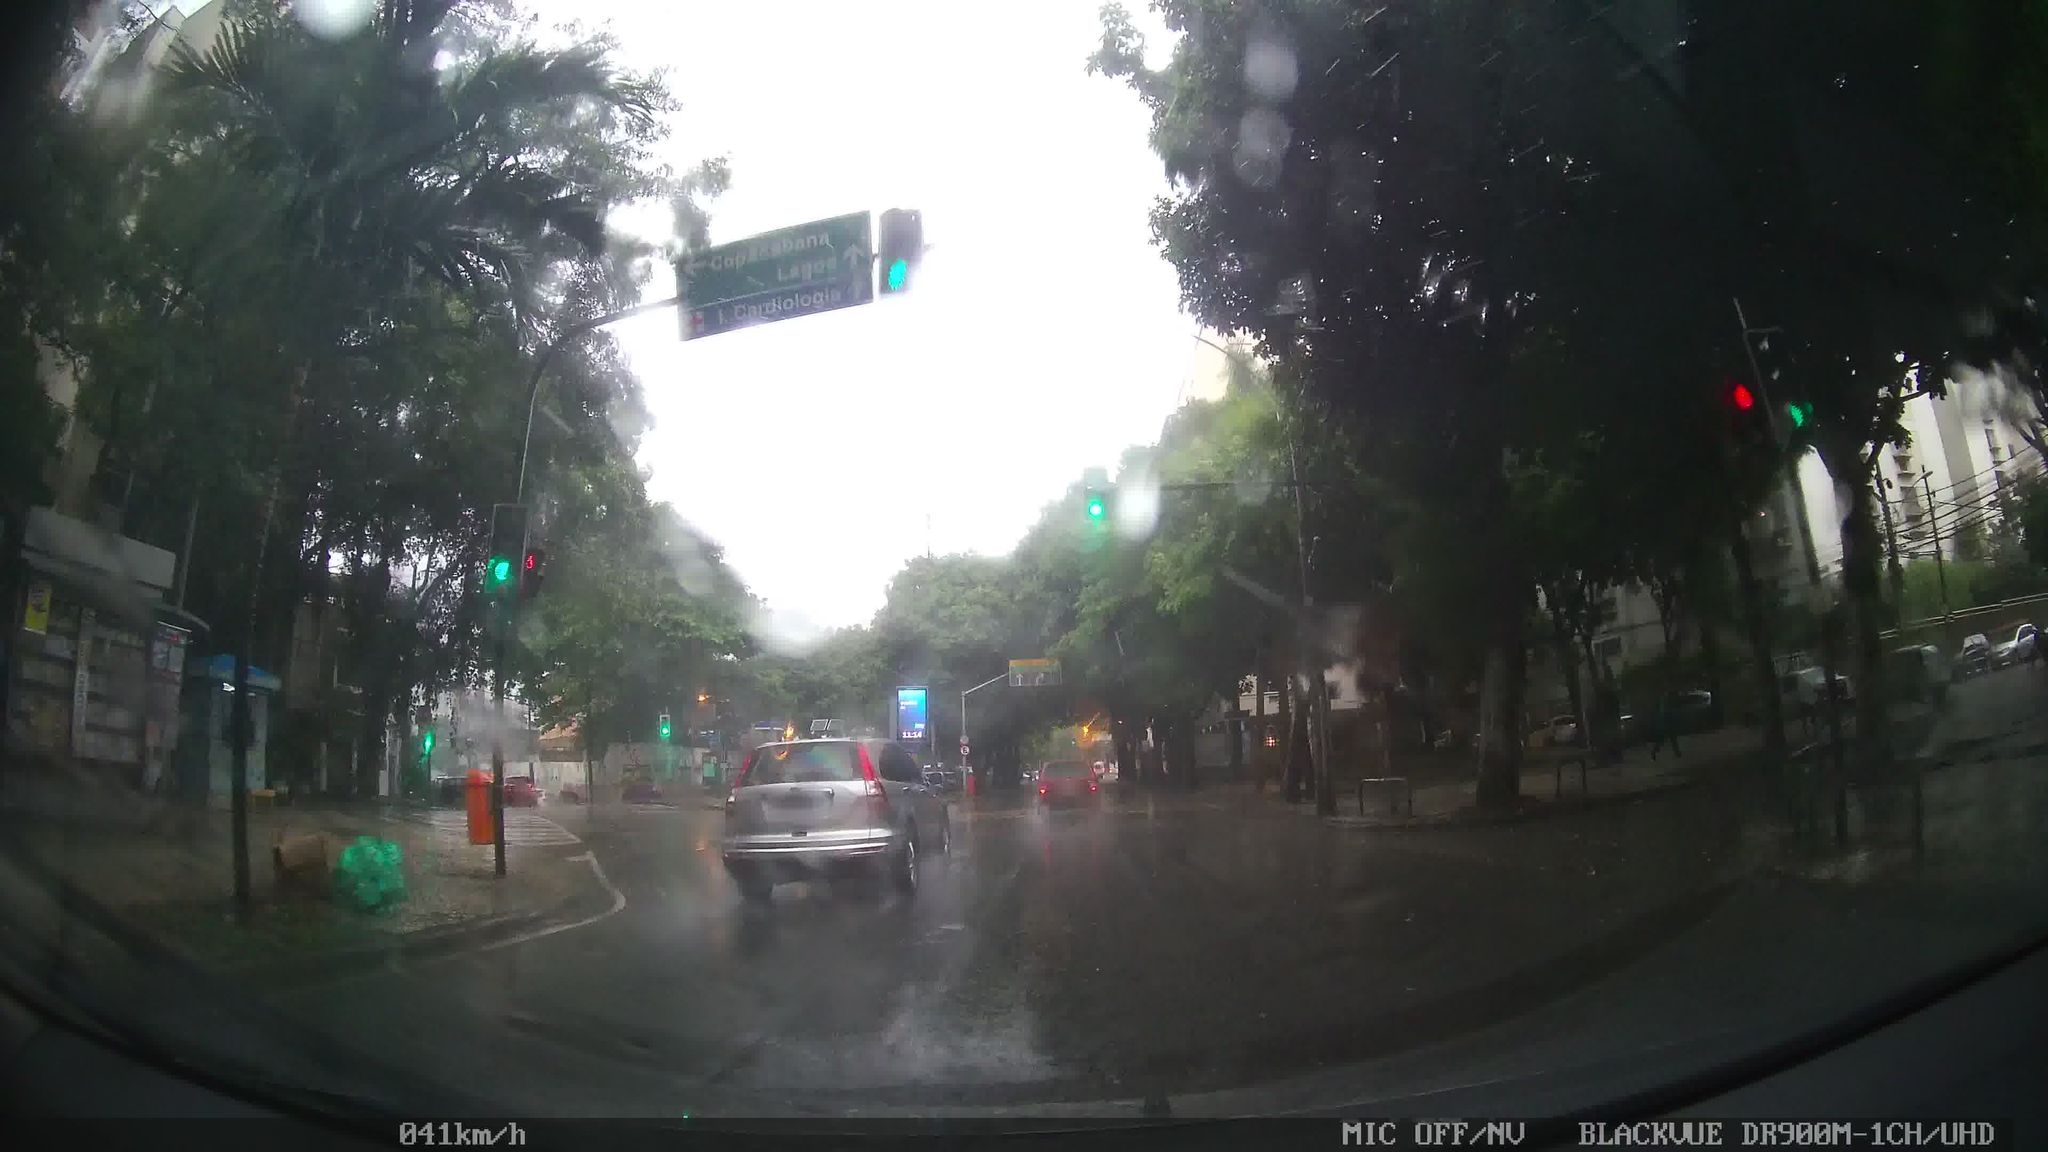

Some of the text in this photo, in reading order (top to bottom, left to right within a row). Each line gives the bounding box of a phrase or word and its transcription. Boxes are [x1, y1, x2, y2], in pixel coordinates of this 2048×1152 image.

[710, 232, 831, 272] Copacabana
[778, 256, 837, 282] Lagoa
[734, 287, 842, 320] Cardiologia
